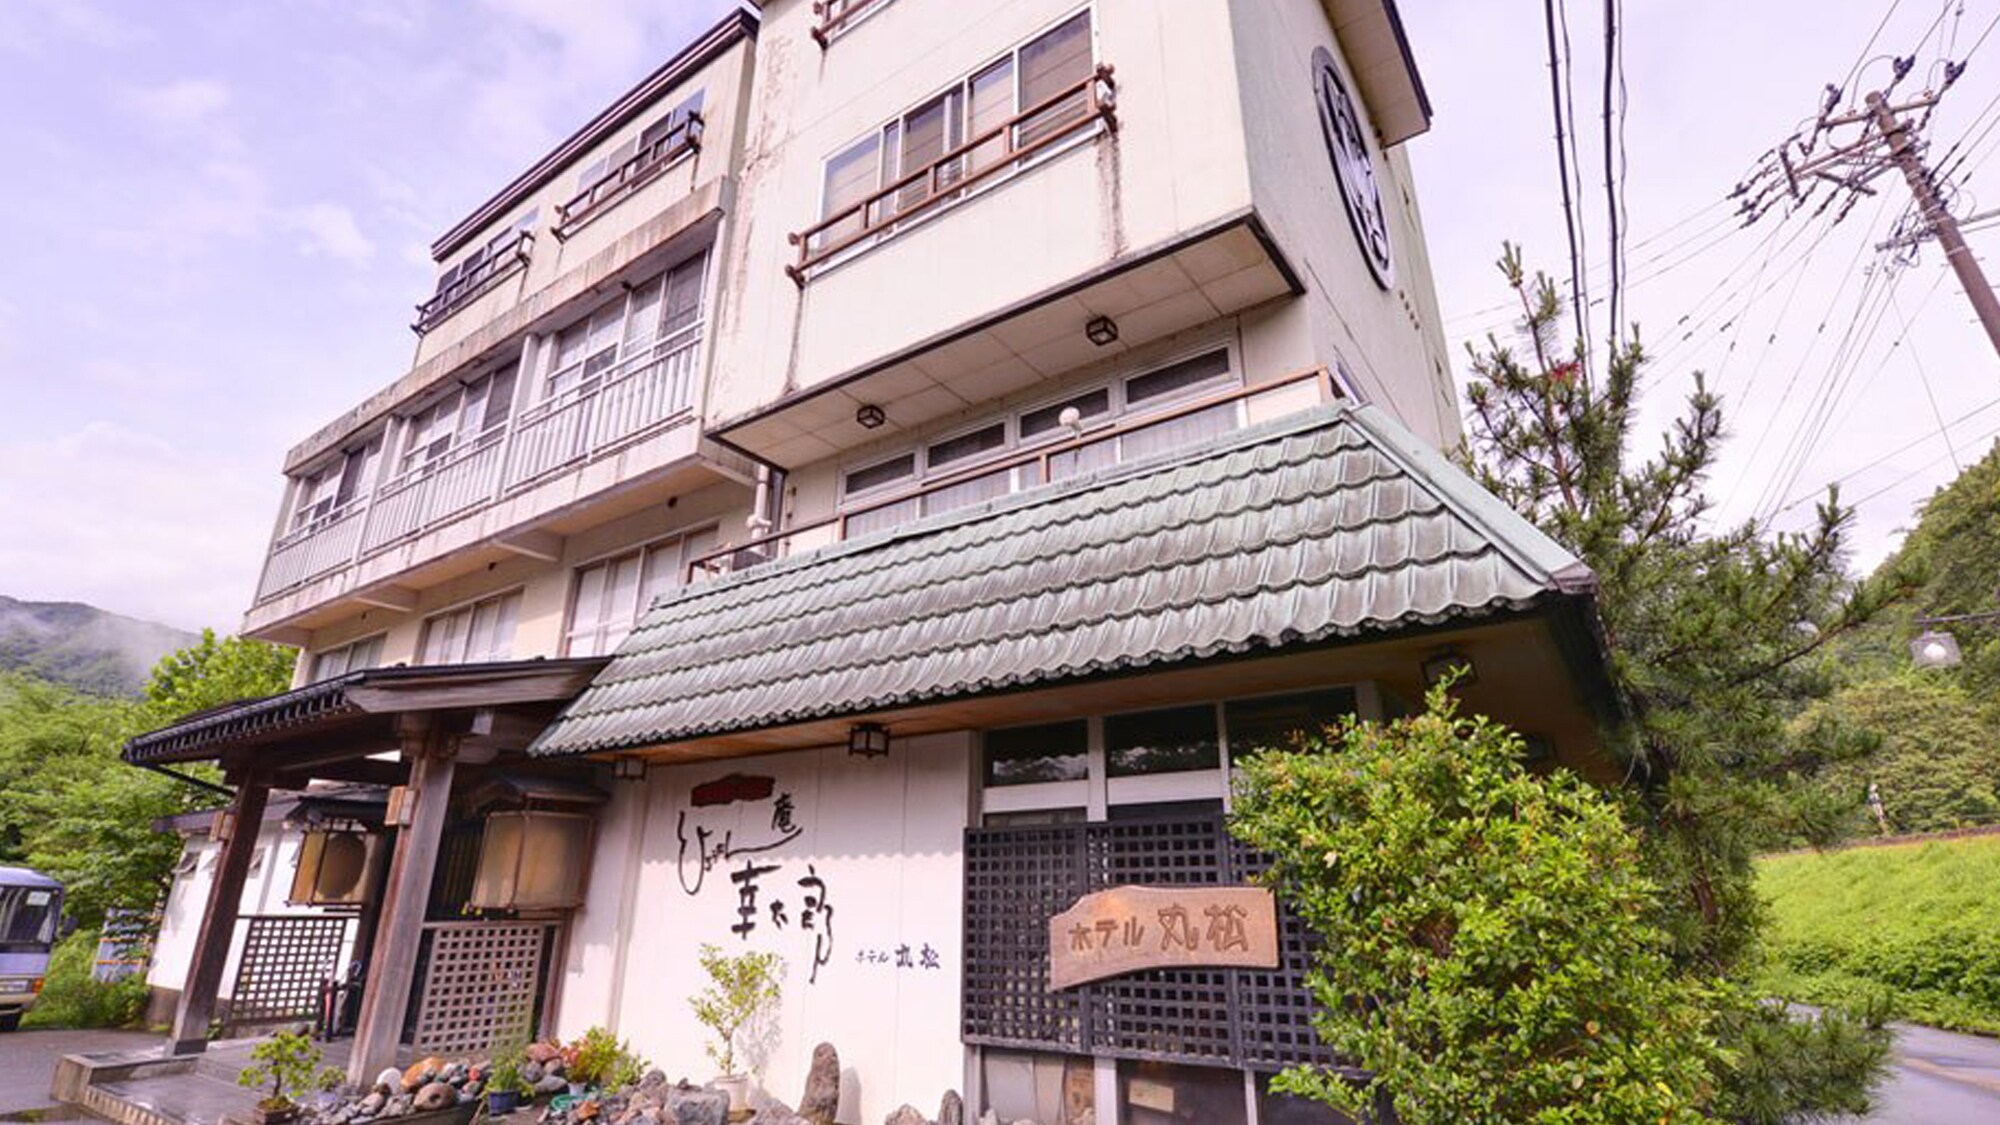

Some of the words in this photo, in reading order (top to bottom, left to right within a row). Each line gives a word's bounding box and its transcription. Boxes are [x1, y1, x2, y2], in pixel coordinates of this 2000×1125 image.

[1069, 904, 1248, 951] ホテル丸松
